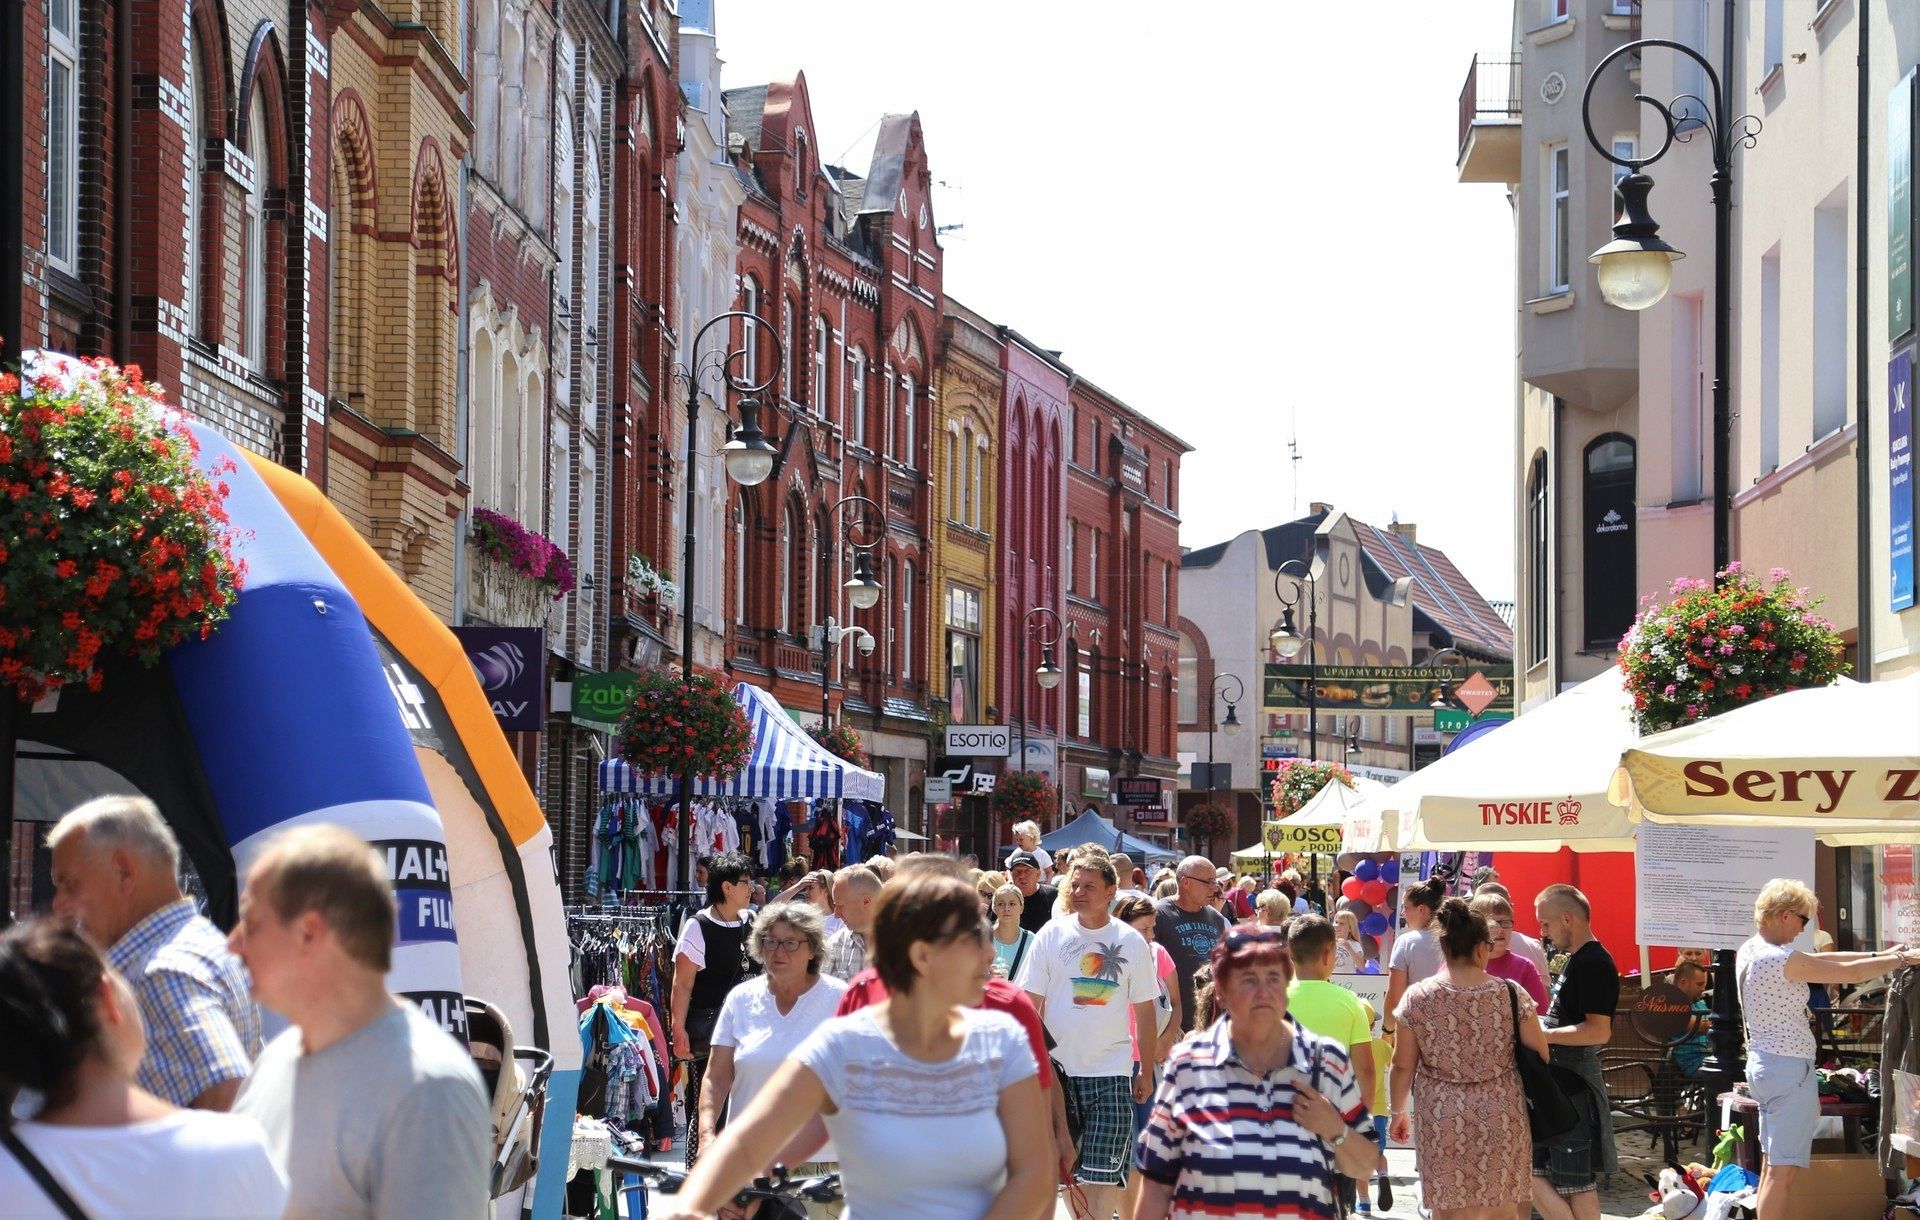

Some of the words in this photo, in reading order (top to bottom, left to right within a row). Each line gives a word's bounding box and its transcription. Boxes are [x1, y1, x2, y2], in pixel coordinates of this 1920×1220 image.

[1324, 667, 1372, 677] UPAJAMY
[1683, 760, 1857, 813] Sery
[1883, 768, 1920, 802] z
[1478, 802, 1552, 825] TYSKIE
[1175, 923, 1192, 933] TOM
[1181, 937, 1191, 946] 19
